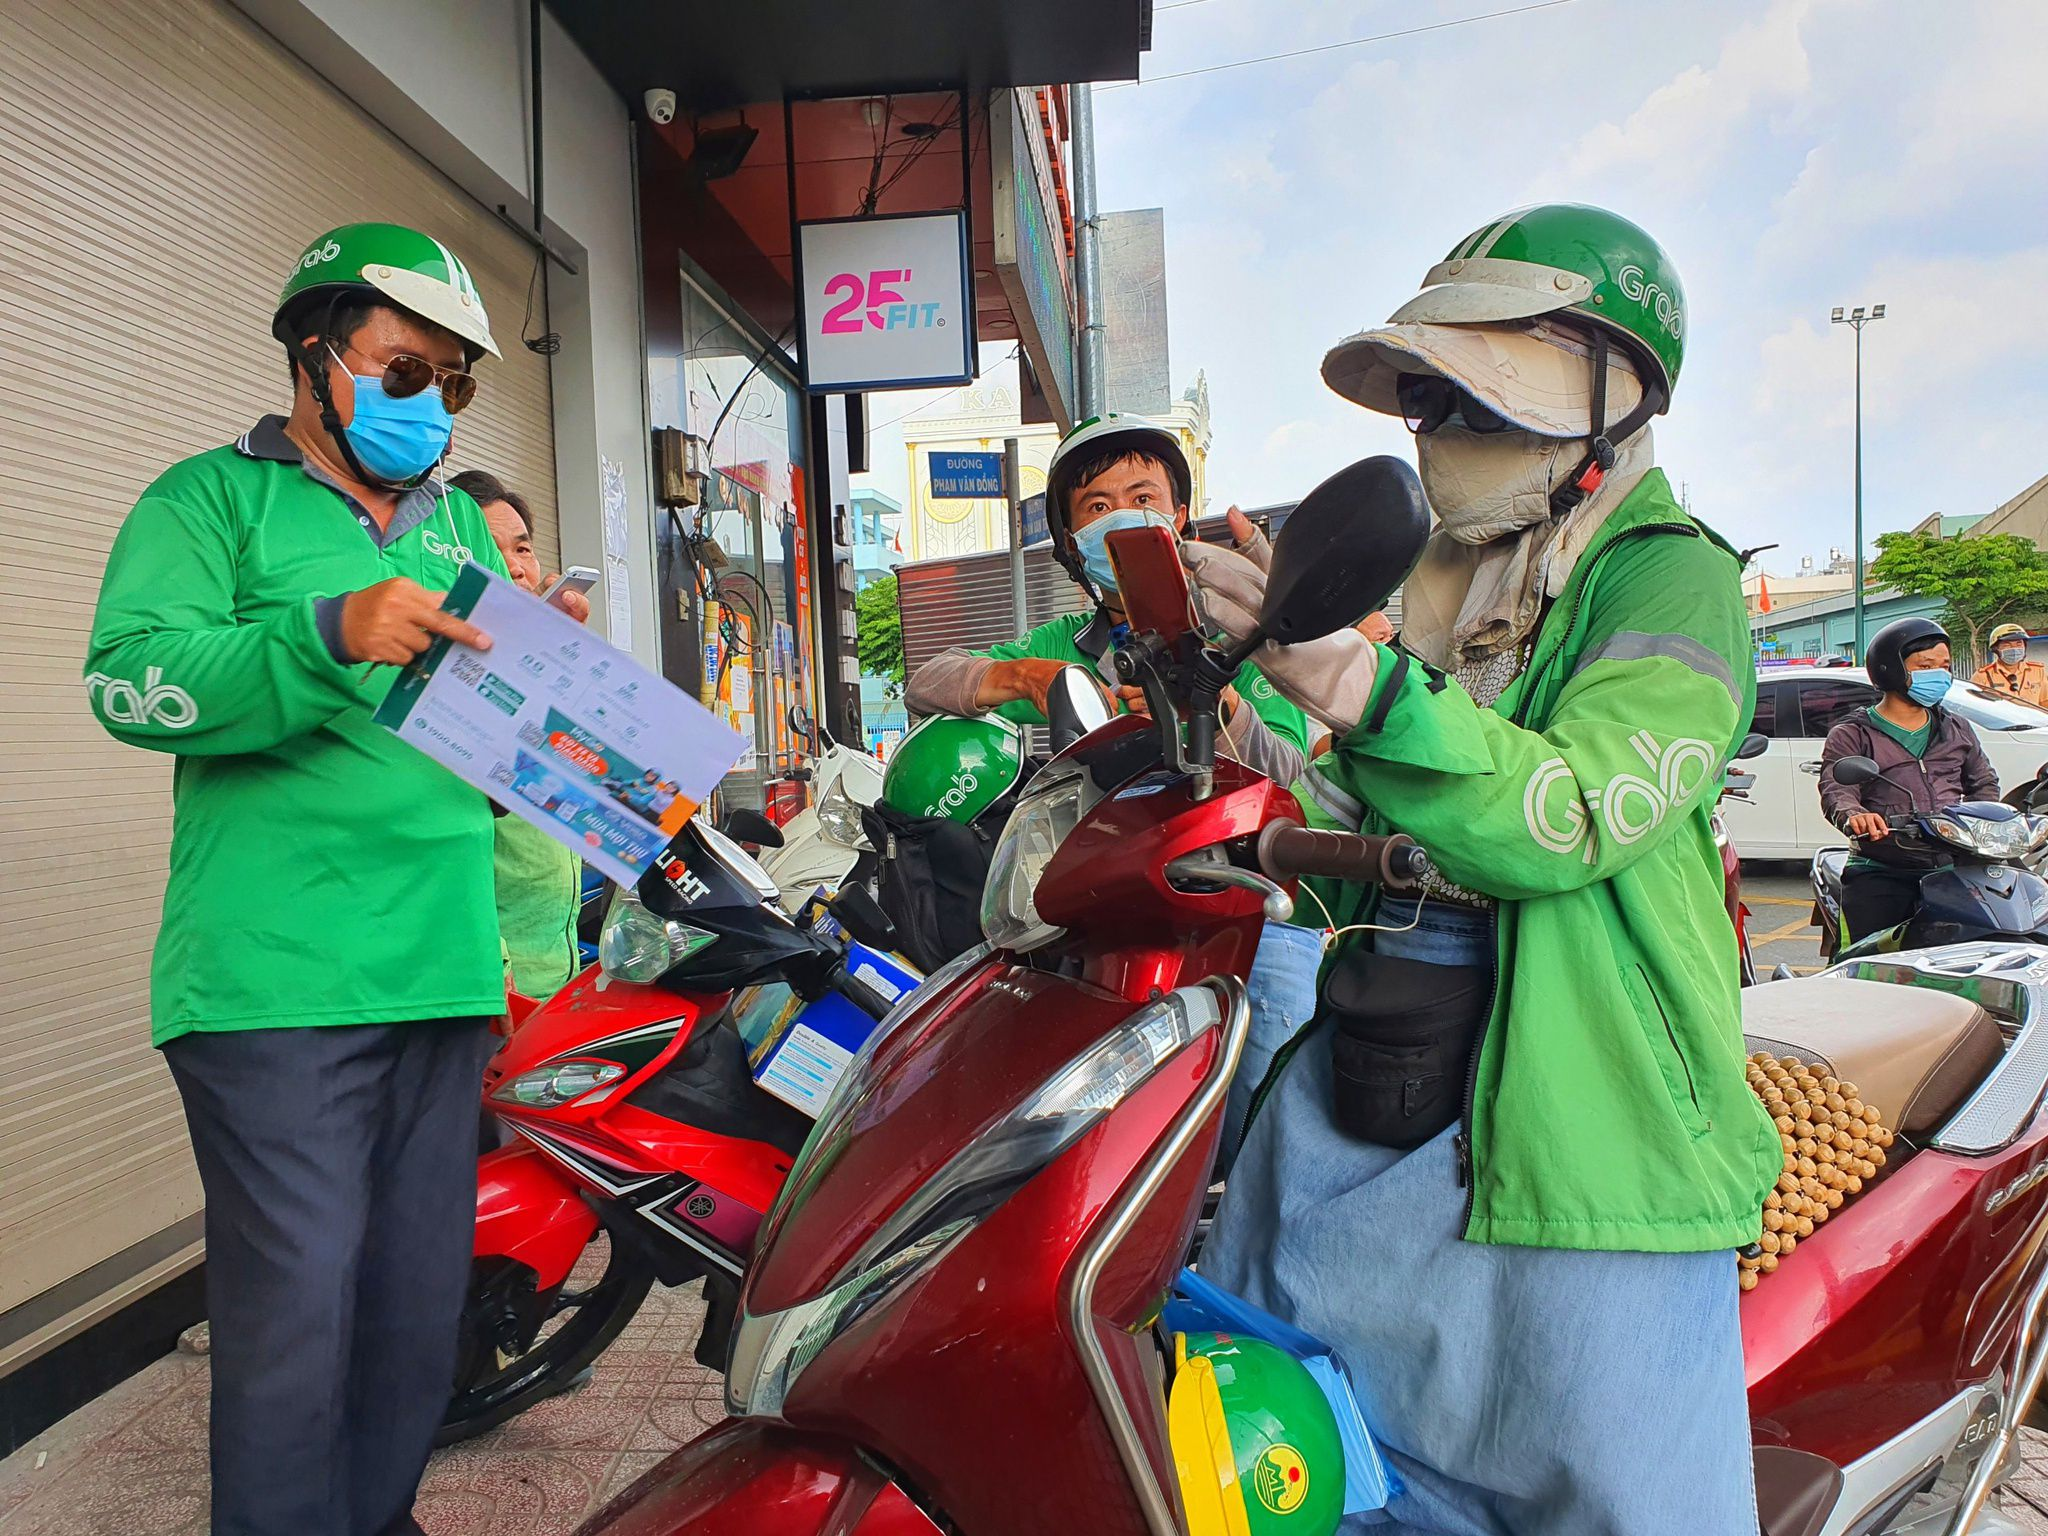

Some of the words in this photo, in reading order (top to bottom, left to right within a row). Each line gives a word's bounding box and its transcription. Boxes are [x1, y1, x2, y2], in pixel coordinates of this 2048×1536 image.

[887, 303, 940, 330] FIT
[1618, 265, 1682, 339] Grab
[960, 387, 1017, 411] KA
[947, 457, 983, 470] ĐƯỜNG
[959, 476, 975, 492] VĂN
[423, 530, 473, 564] Gra
[85, 666, 199, 729] rab
[1523, 729, 1715, 865] Grab
